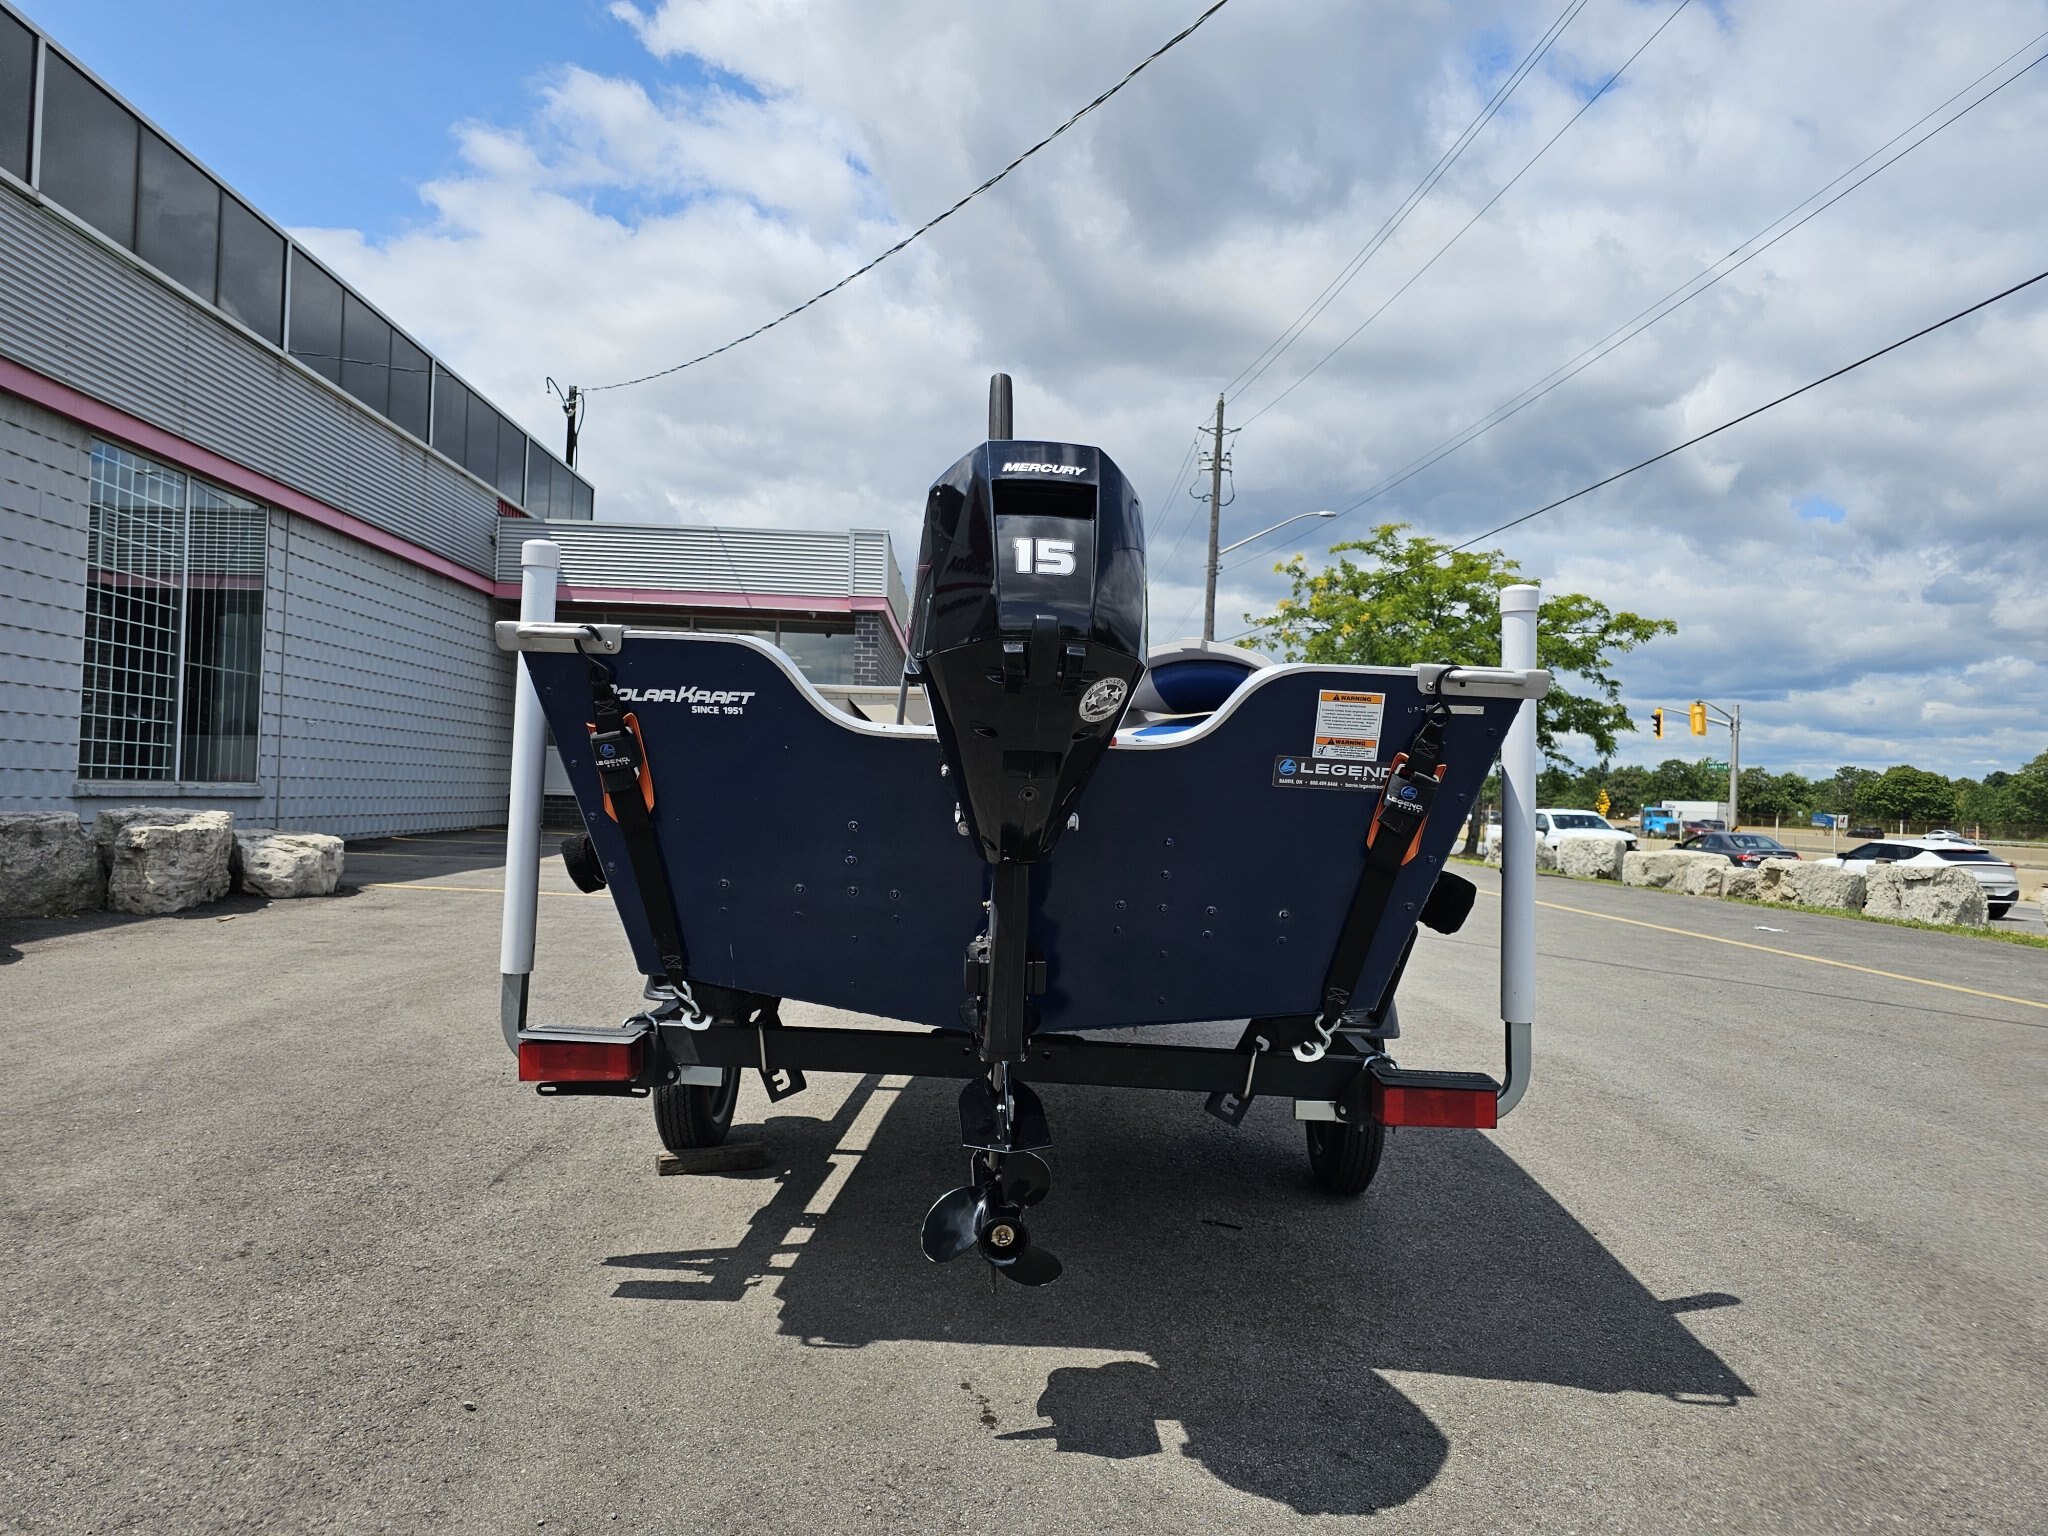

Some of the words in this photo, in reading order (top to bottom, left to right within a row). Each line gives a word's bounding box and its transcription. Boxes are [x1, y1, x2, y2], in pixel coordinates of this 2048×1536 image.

[1002, 462, 1087, 476] MERCURY
[1013, 537, 1077, 576] 15
[691, 705, 720, 714] SINCE
[723, 706, 744, 715] 1951
[1386, 794, 1422, 811] LEGEND
